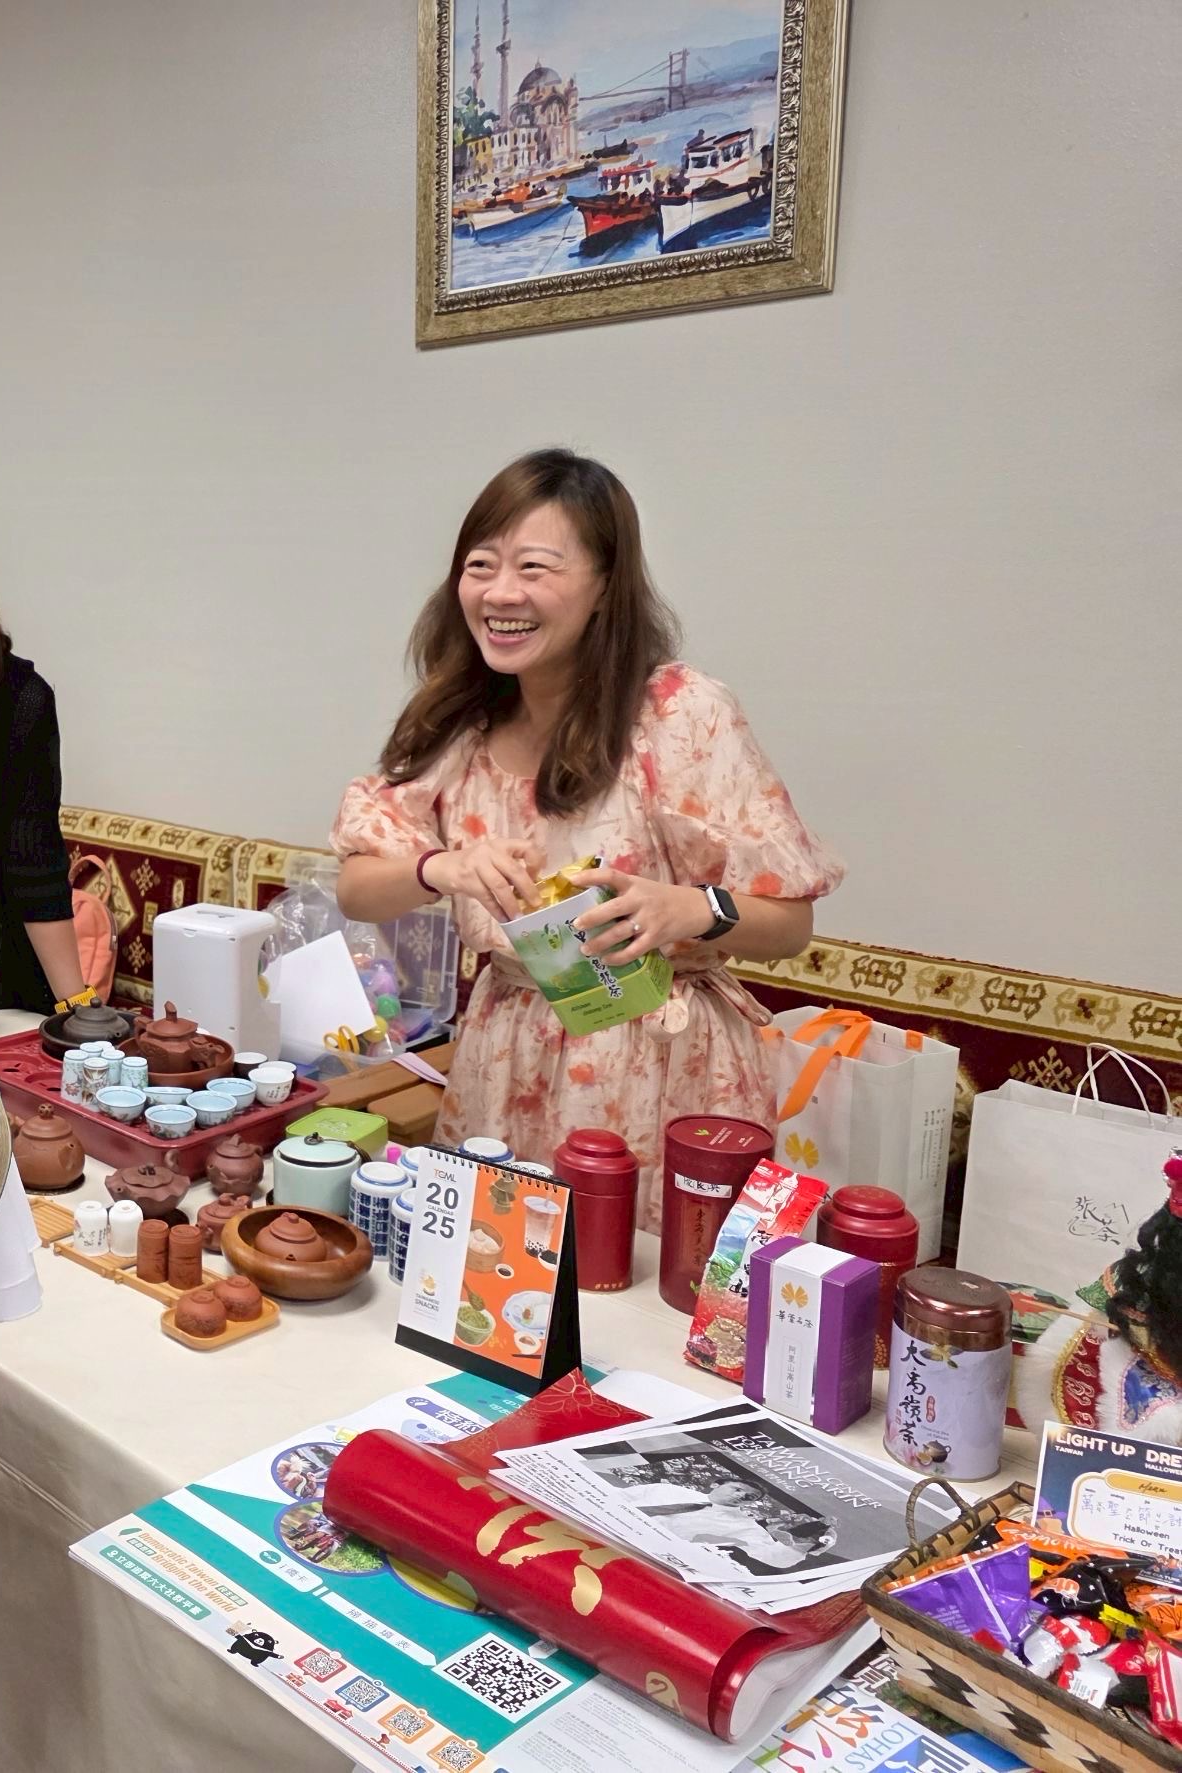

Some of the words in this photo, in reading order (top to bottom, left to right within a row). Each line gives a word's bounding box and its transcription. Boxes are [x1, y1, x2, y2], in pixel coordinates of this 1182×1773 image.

[426, 1182, 459, 1210] 20
[422, 1211, 456, 1240] 25
[723, 1437, 815, 1489] LEARNING
[1054, 1445, 1084, 1457] TAIWAN
[1056, 1432, 1108, 1452] LIGHT
[1111, 1443, 1136, 1457] UP
[751, 1431, 829, 1477] TAIWAN
[826, 1476, 883, 1510] CENTER
[758, 1445, 868, 1509] MANDARIN
[1112, 1532, 1136, 1545] Trick
[1140, 1540, 1153, 1548] Or
[1123, 1523, 1170, 1540] Halloween
[138, 1533, 188, 1565] Democratic
[189, 1561, 218, 1587] Taiwan
[152, 1553, 191, 1582] Bridging
[189, 1577, 208, 1593] the
[205, 1589, 238, 1613] World
[844, 1720, 919, 1769] LOHAS
